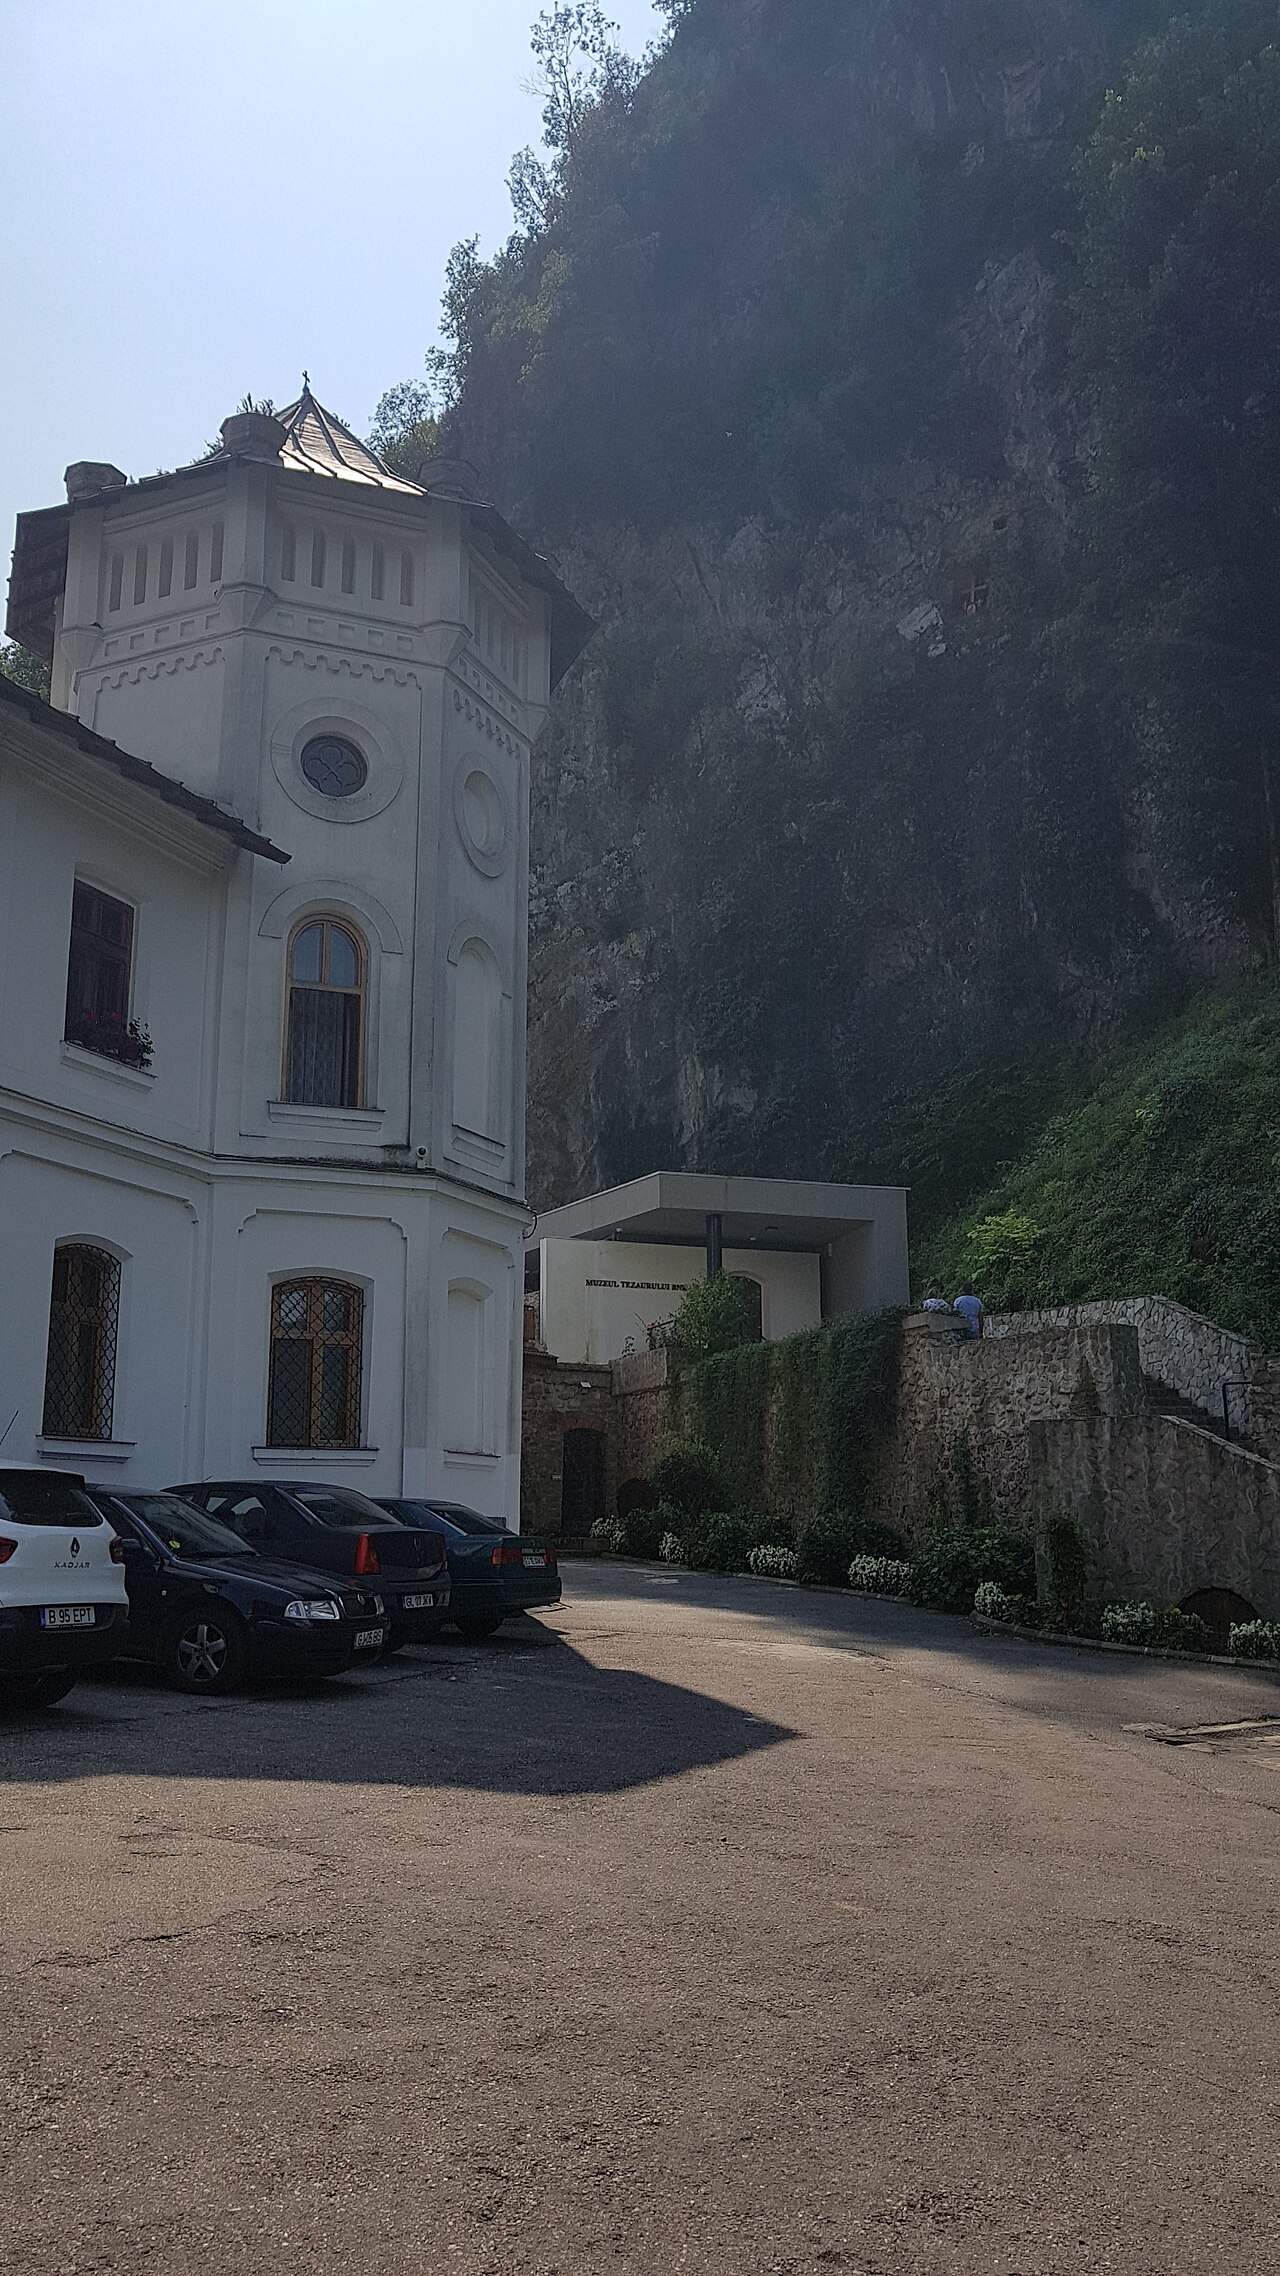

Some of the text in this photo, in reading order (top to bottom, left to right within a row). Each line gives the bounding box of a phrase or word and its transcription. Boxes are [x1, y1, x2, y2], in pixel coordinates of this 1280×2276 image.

[585, 1279, 619, 1288] MUZEUL
[620, 1281, 670, 1290] TEZAURULUI
[54, 1561, 90, 1569] KADJAR
[48, 1607, 91, 1623] B 95 EPT
